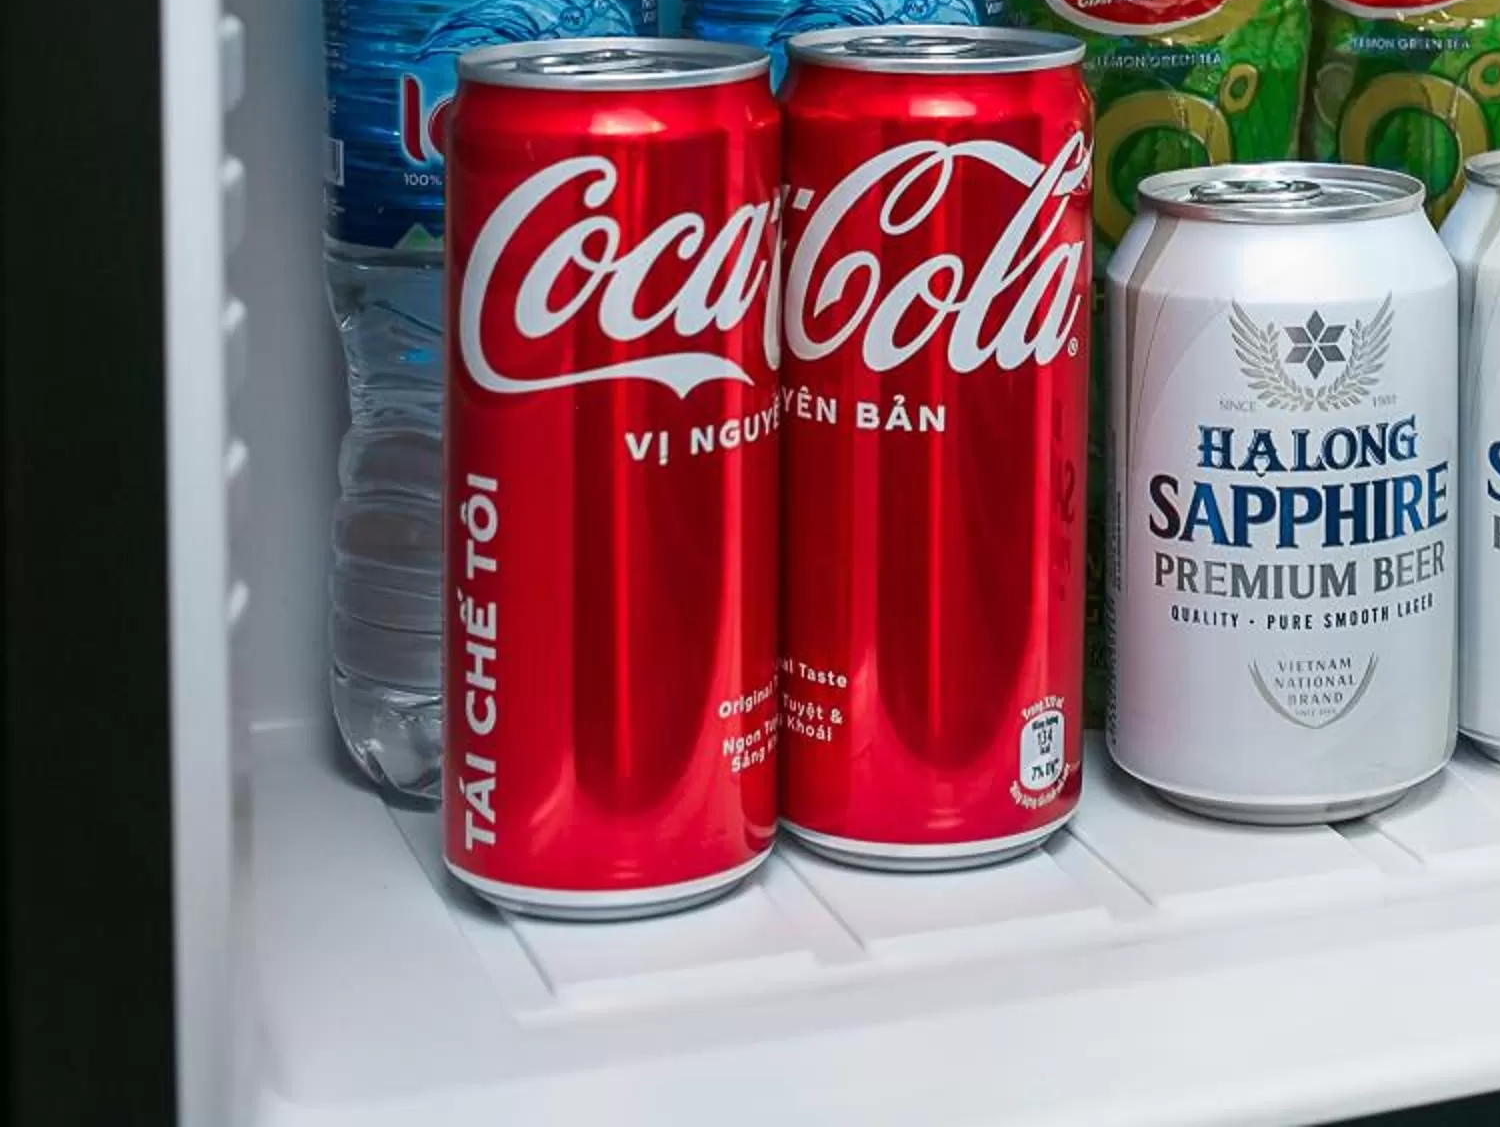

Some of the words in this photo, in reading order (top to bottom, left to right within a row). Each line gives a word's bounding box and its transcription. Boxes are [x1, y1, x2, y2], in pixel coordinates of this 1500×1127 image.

[856, 393, 946, 432] BẢN
[624, 431, 669, 466] VỊ
[1148, 461, 1450, 550] SAPPHIRE
[460, 473, 499, 581] TÔI
[1153, 551, 1358, 601] PREMIUM
[1373, 539, 1445, 595] BEER
[1170, 604, 1240, 630] QUALITY
[1265, 608, 1314, 631] PURE
[1322, 606, 1390, 630] SMOOTH
[456, 586, 498, 737] CHẾ
[798, 662, 848, 688] Taste
[1278, 657, 1352, 673] VIETNAM
[1275, 673, 1357, 689] NATIONAL
[830, 707, 843, 725] &
[1287, 691, 1344, 707] BRAND
[458, 756, 497, 851] TÁI
